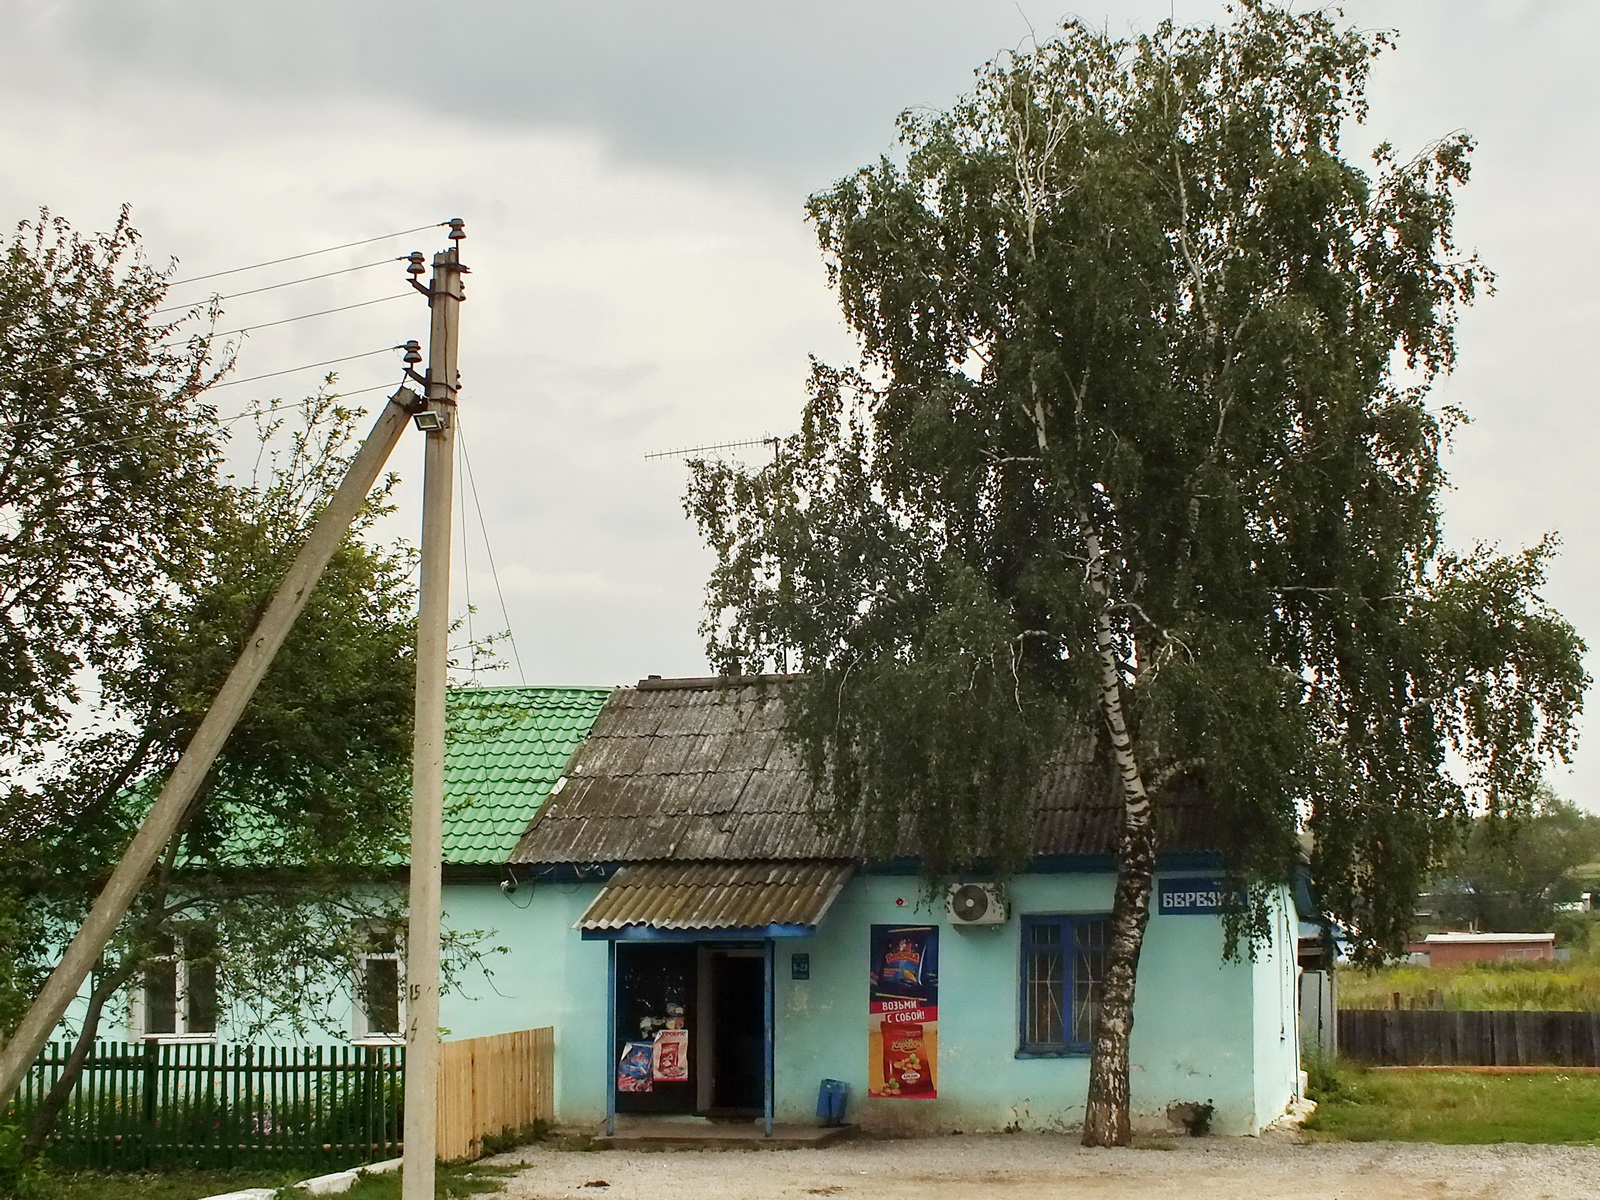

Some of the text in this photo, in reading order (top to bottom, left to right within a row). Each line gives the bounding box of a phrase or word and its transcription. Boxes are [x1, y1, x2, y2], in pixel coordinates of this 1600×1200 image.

[410, 984, 421, 1001] 15
[882, 1001, 917, 1011] ВОЗЬМИ
[887, 1010, 925, 1023] С СОБОЙ!
